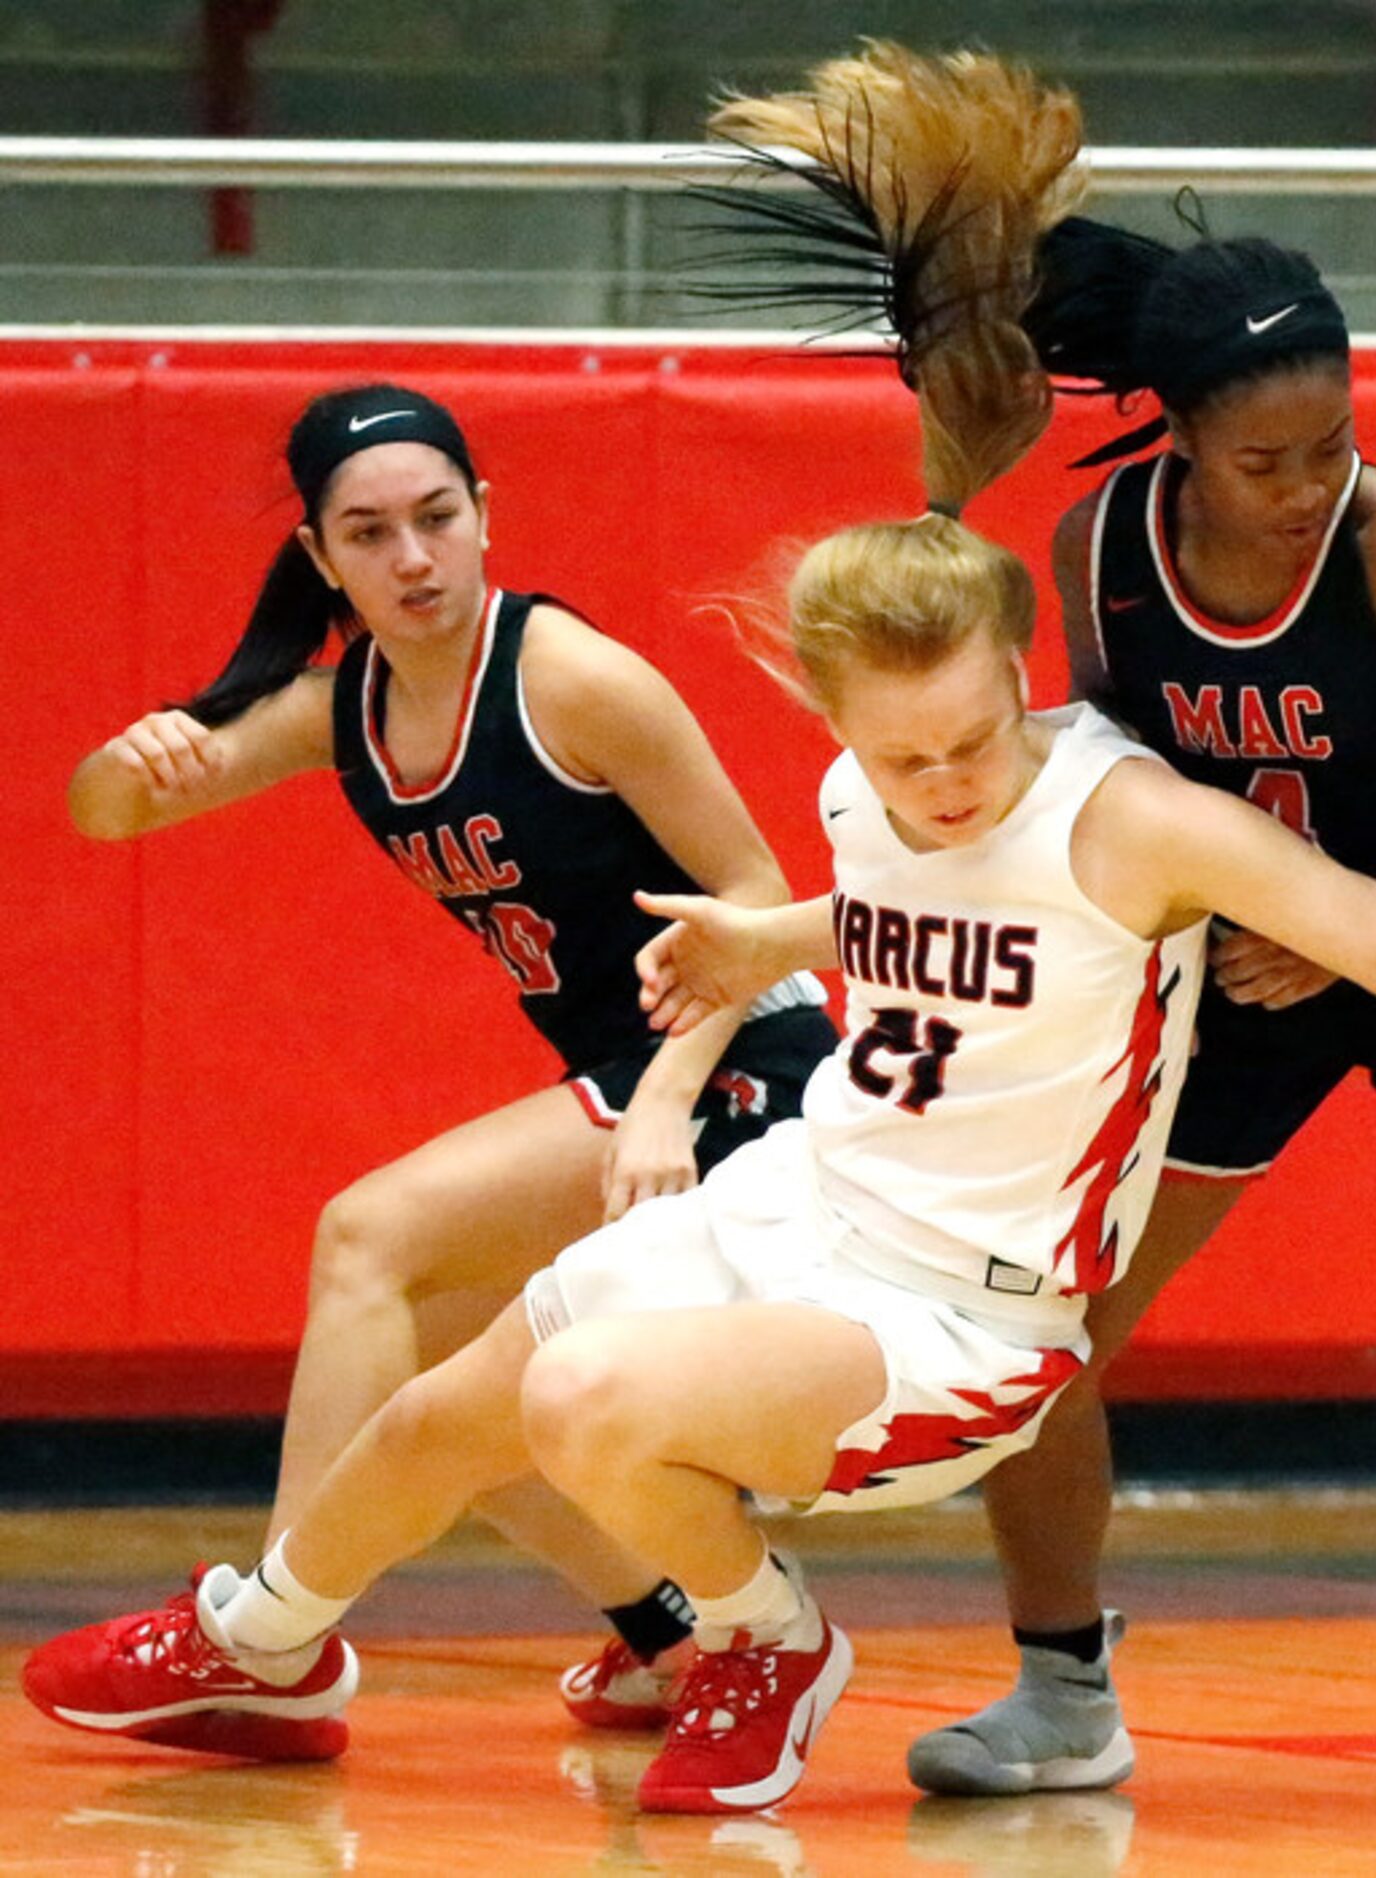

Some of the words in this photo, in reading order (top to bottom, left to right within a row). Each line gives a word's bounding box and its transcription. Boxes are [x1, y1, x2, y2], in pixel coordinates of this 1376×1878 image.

[1161, 682, 1334, 760] MAC
[386, 813, 522, 898] MAC
[848, 1006, 964, 1116] 21
